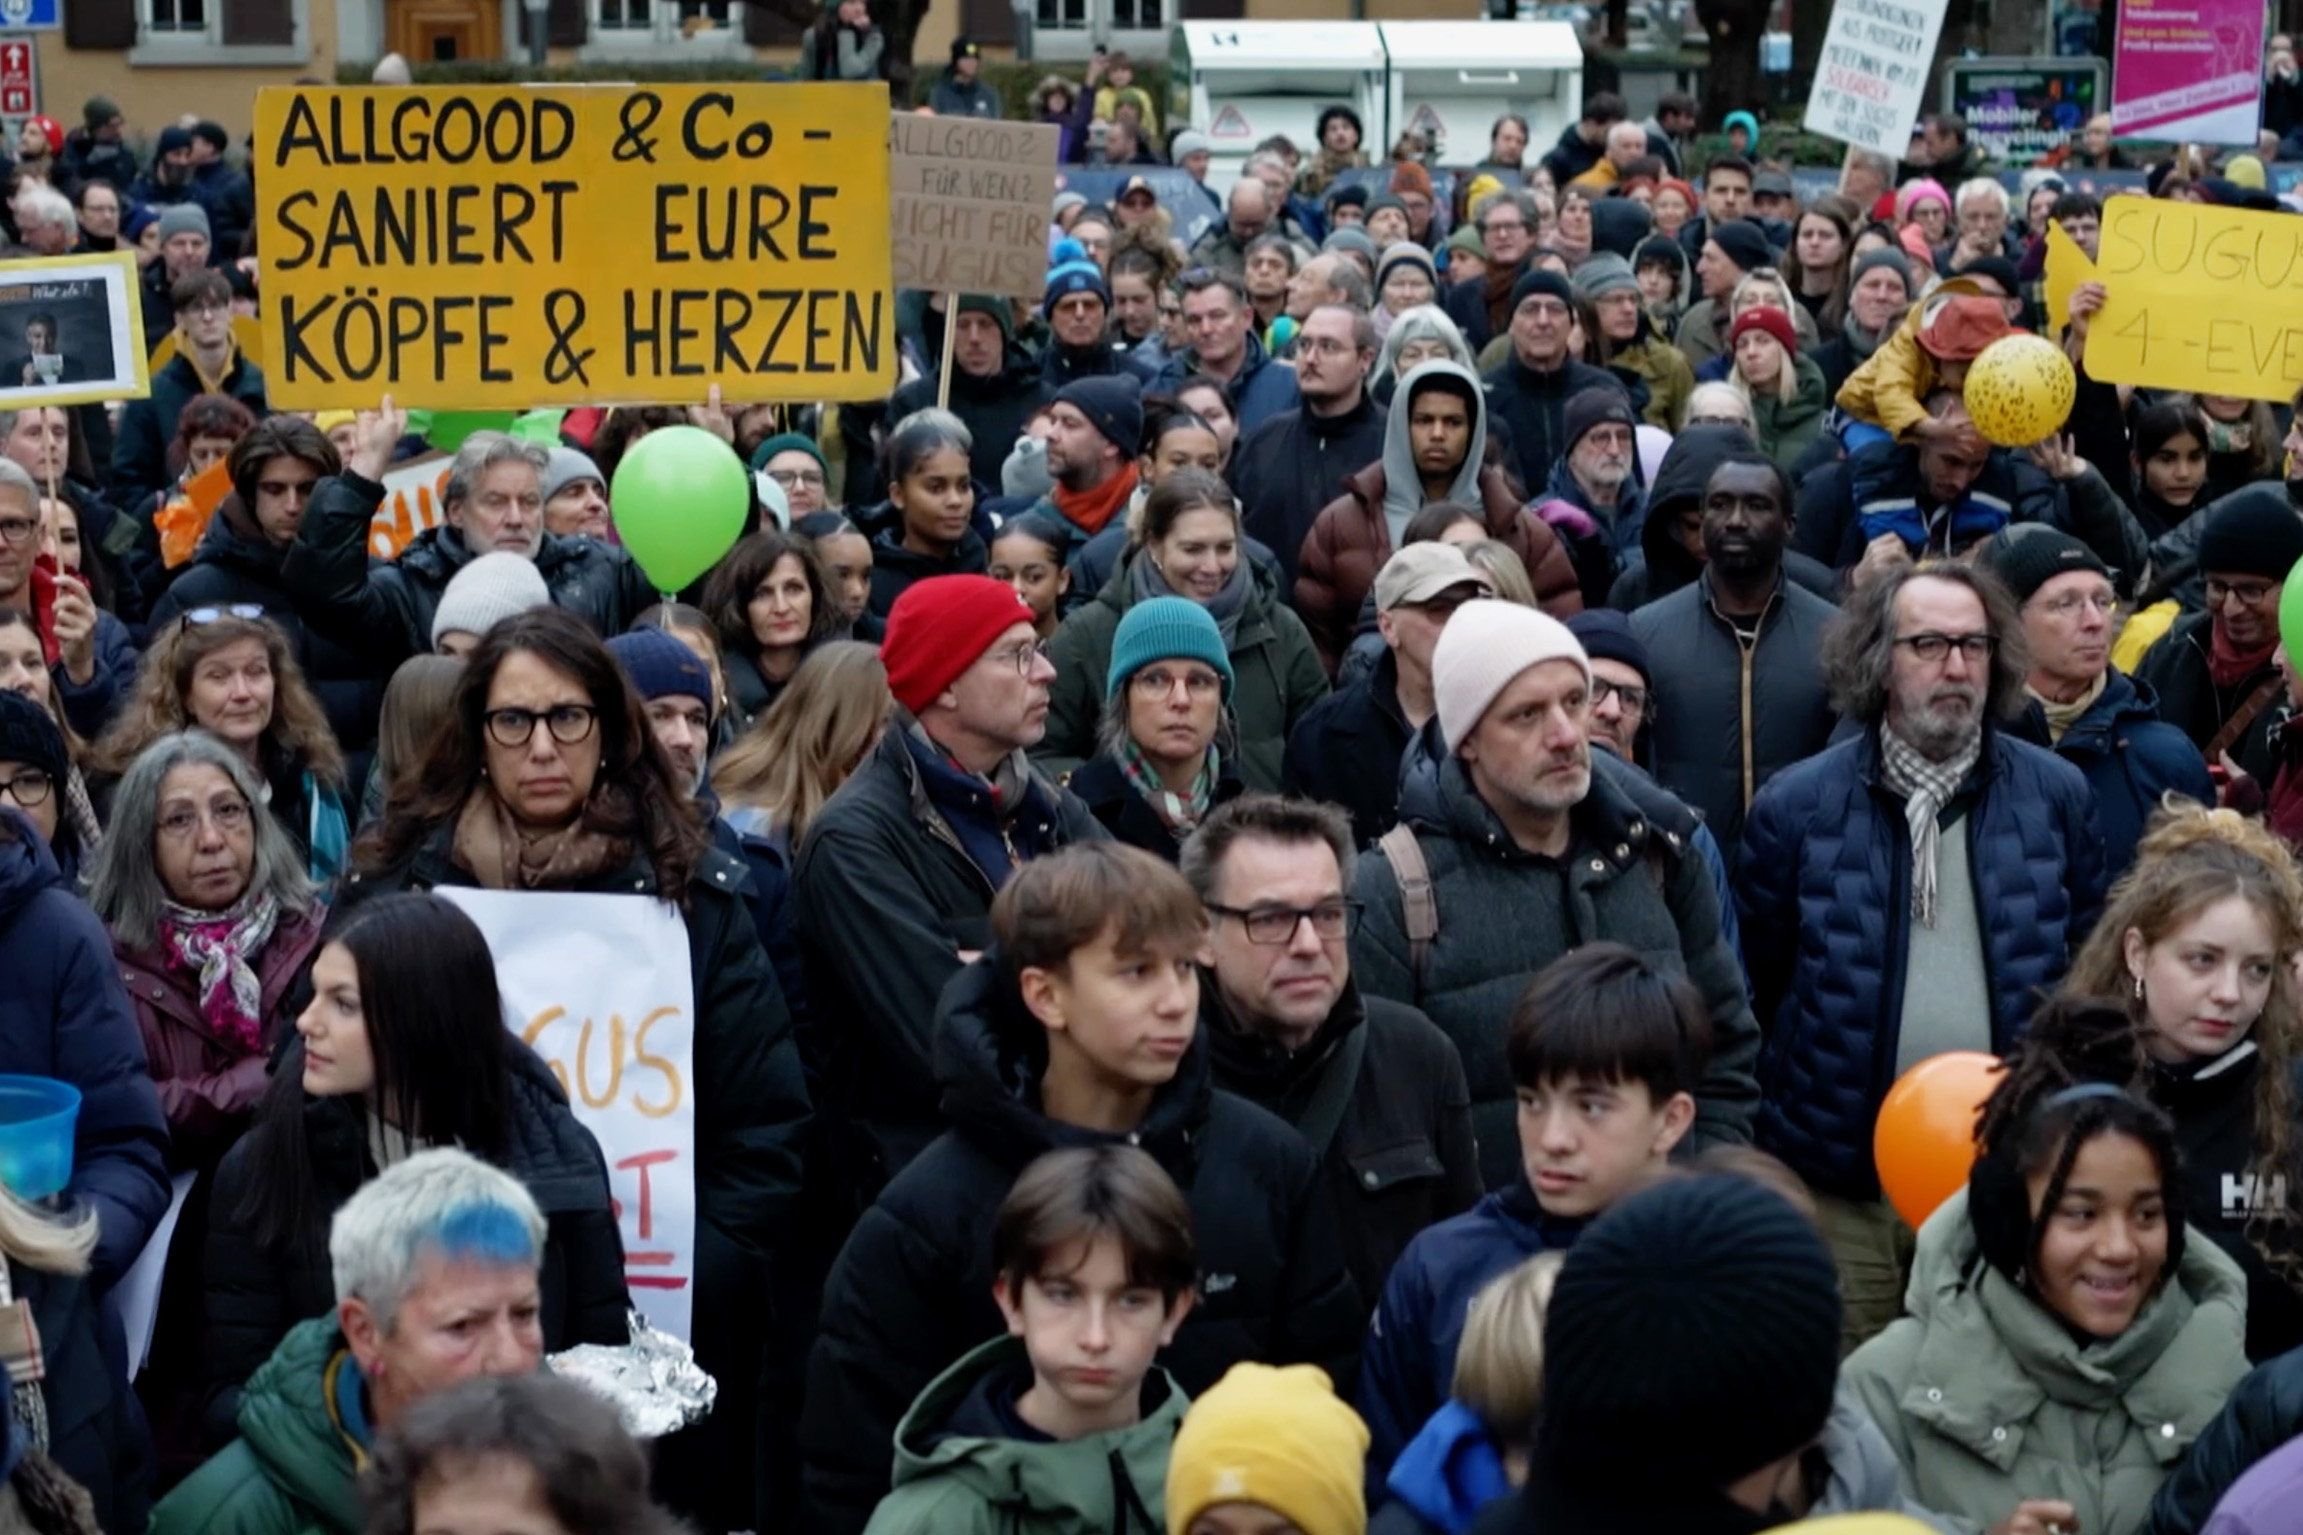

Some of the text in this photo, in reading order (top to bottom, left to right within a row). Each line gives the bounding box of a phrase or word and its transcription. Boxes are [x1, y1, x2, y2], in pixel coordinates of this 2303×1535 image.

[275, 94, 574, 168] ALLGOOD
[612, 92, 662, 163] &
[682, 92, 773, 160] Co
[1966, 105, 2041, 124] Mobiler
[921, 164, 1032, 201] FÜR WEN?
[275, 181, 838, 270] SANIERT EURE
[988, 205, 1044, 247] FÜR
[2110, 209, 2303, 289] SUGU
[281, 286, 882, 387] KÖPFE & HERZEN
[2221, 1172, 2286, 1209] HH
